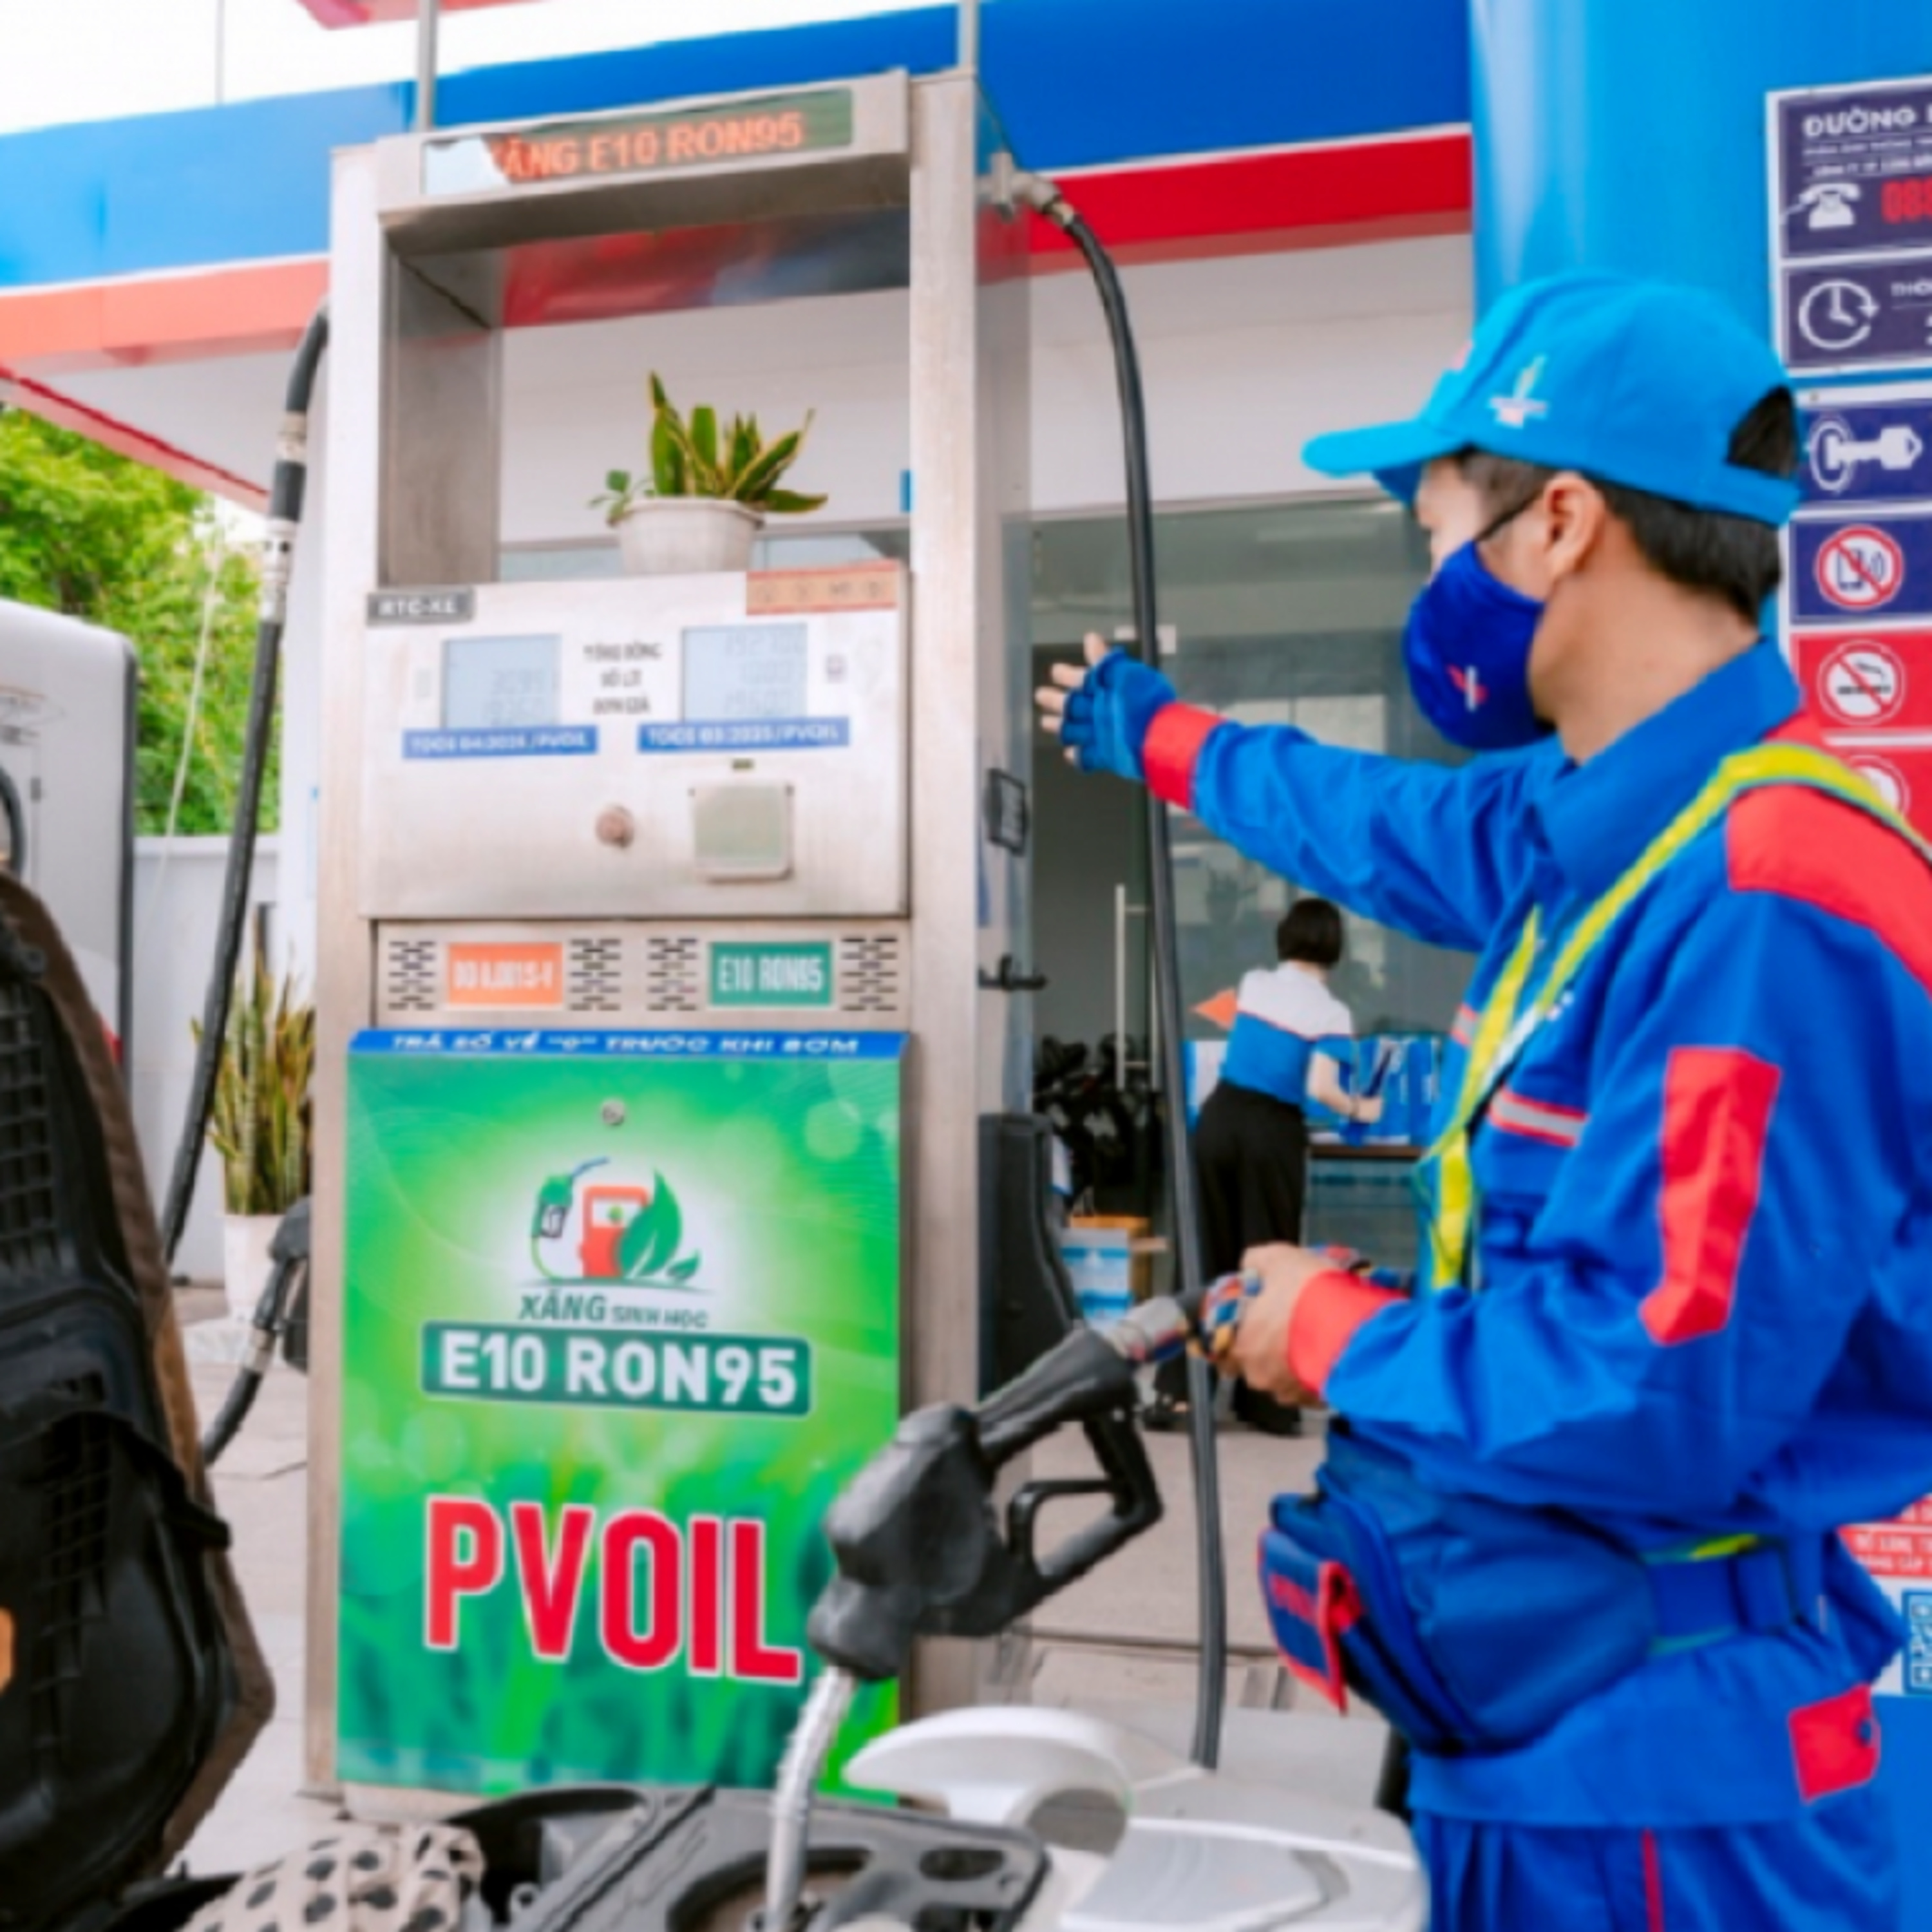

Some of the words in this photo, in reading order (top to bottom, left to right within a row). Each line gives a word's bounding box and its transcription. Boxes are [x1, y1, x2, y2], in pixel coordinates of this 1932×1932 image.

[590, 129, 658, 171] E10
[667, 111, 803, 162] RON95
[719, 956, 753, 992] E10
[719, 1037, 773, 1052] KHI
[440, 1330, 546, 1392] E10
[566, 1337, 797, 1406] RON95
[424, 1493, 802, 1687] PVOIL
